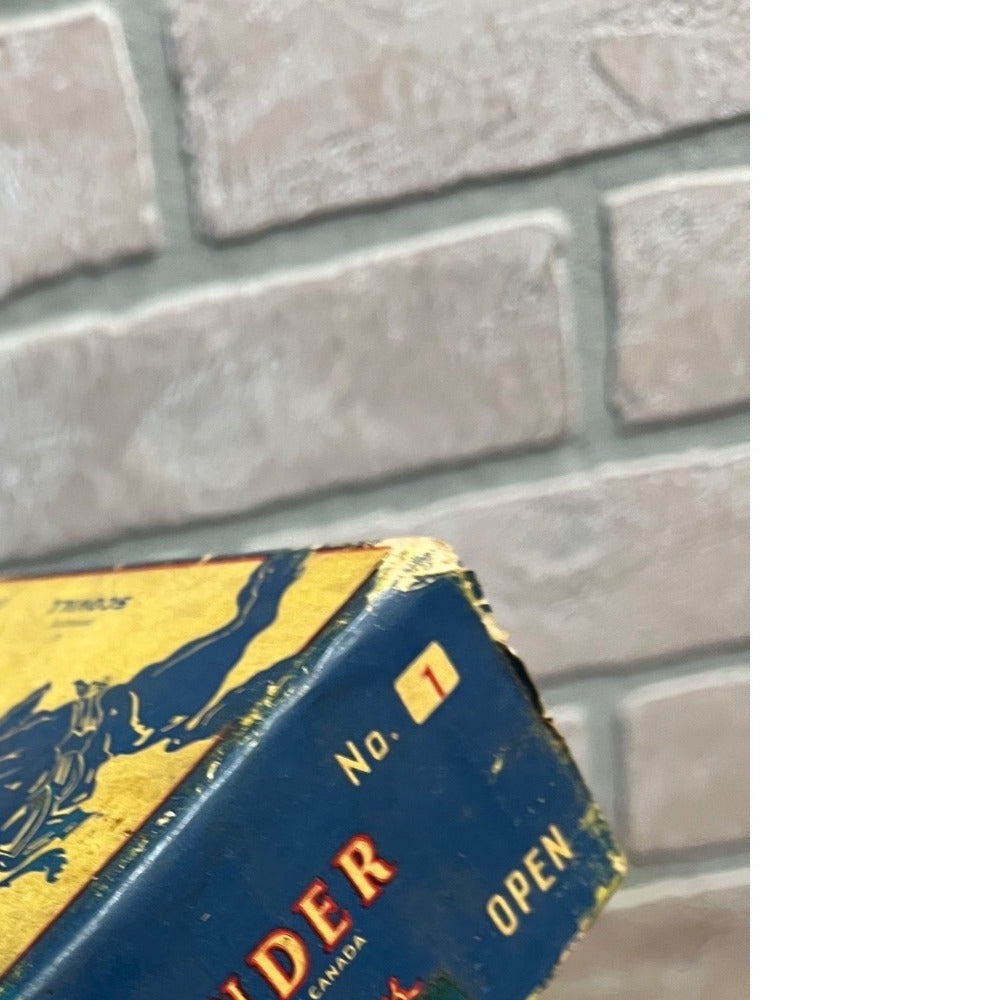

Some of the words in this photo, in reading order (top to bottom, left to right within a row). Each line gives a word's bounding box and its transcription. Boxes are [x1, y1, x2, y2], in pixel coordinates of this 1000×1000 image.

[334, 730, 400, 786] No.
[421, 665, 448, 699] 1
[486, 824, 573, 936] OPEN
[308, 935, 367, 1000] CANADA
